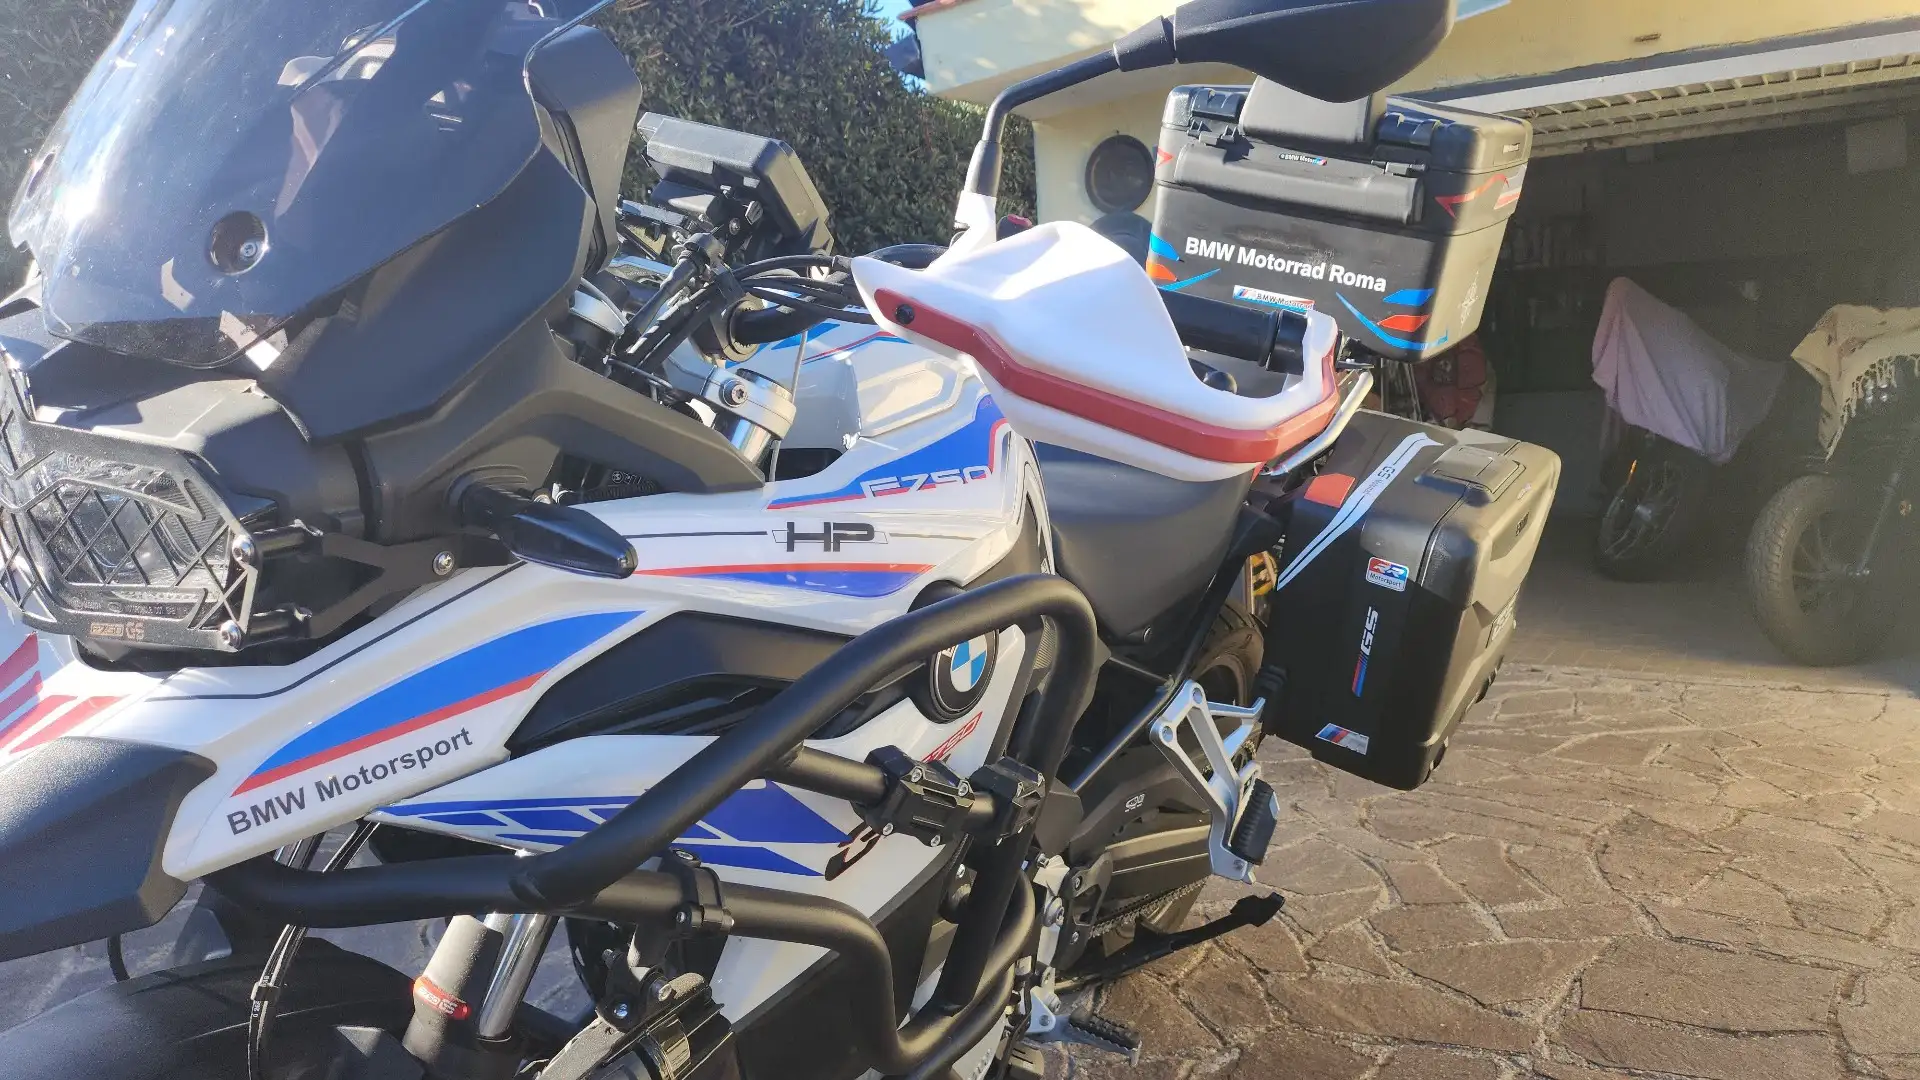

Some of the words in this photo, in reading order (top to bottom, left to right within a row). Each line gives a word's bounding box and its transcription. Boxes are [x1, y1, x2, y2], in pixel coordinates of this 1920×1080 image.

[1185, 236, 1235, 262] BMW
[1236, 246, 1327, 280] Motorrad
[1329, 264, 1387, 293] Roma
[860, 465, 993, 498] F750
[786, 521, 875, 552] HP
[1370, 572, 1401, 588] Motorsport
[125, 621, 144, 640] GS
[1360, 606, 1379, 656] GS
[226, 786, 306, 836] BMW
[314, 727, 473, 802] Motorsport
